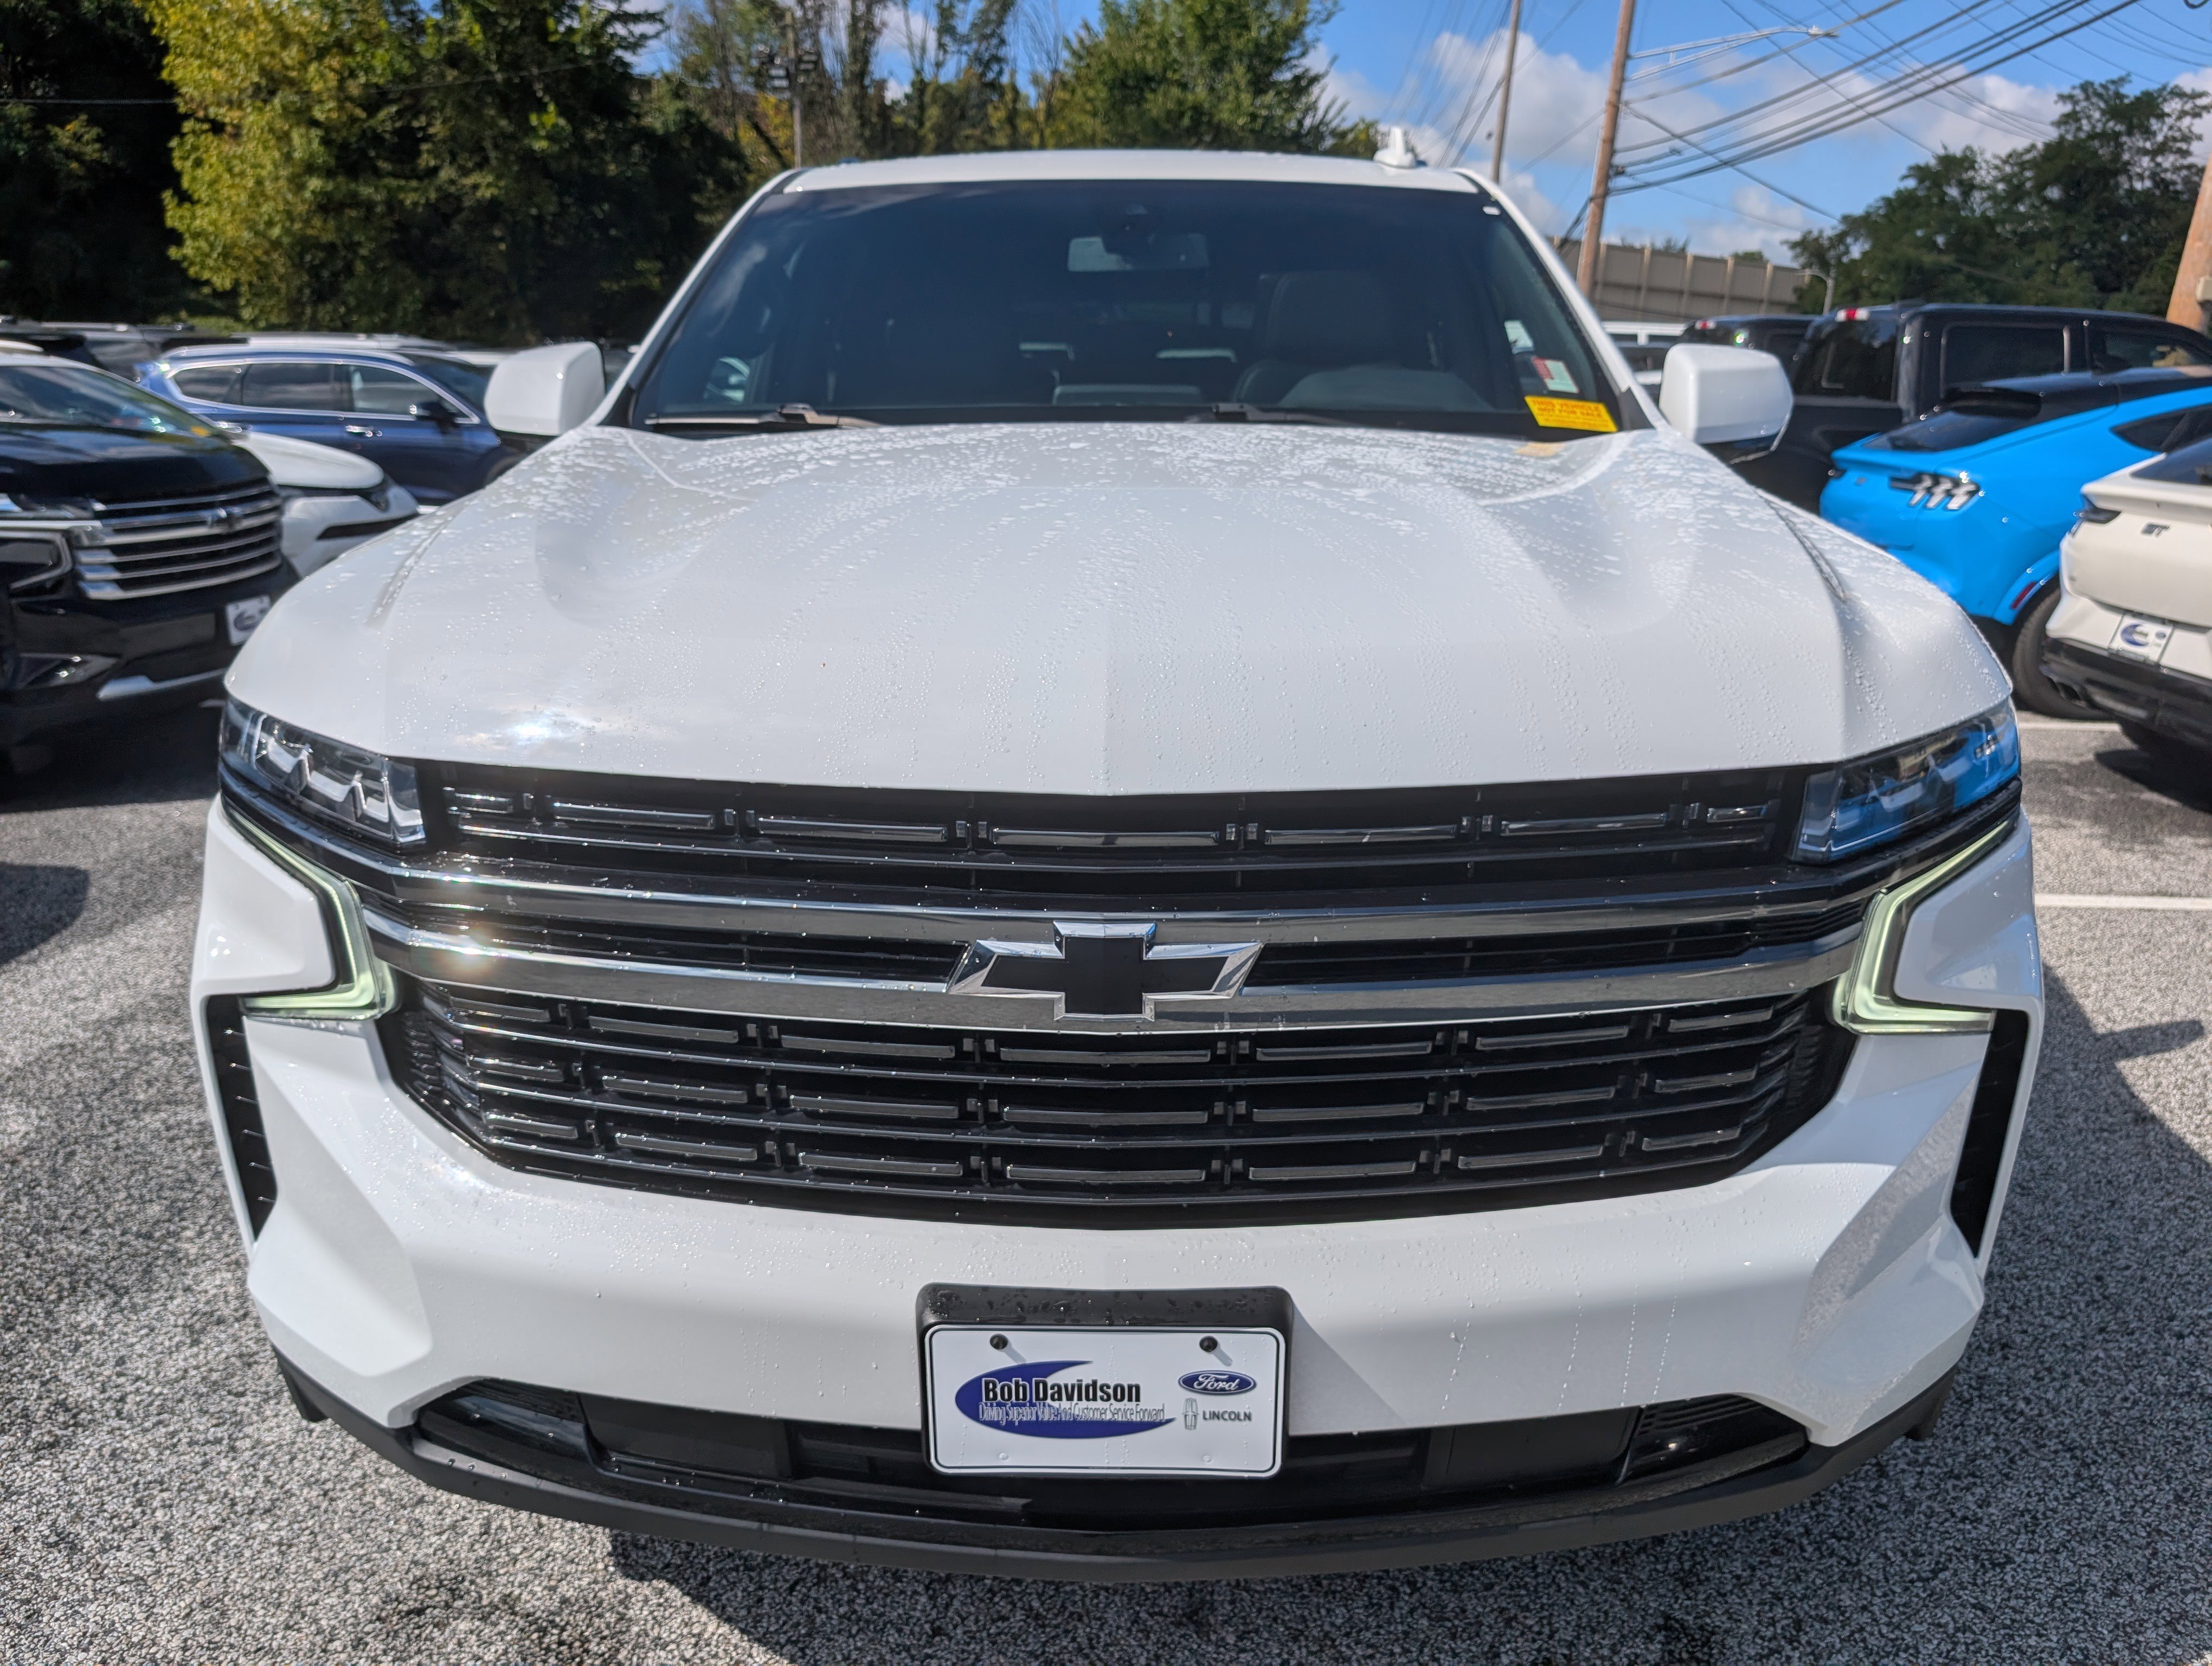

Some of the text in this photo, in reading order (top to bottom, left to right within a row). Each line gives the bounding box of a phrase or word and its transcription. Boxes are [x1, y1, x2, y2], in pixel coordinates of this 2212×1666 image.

[982, 1377, 1141, 1402] Bob Davidson
[1193, 1373, 1240, 1391] Ford
[979, 1401, 1165, 1426] Driving Superior Value And Customer Service Forward
[1202, 1409, 1252, 1421] LINCOLN
